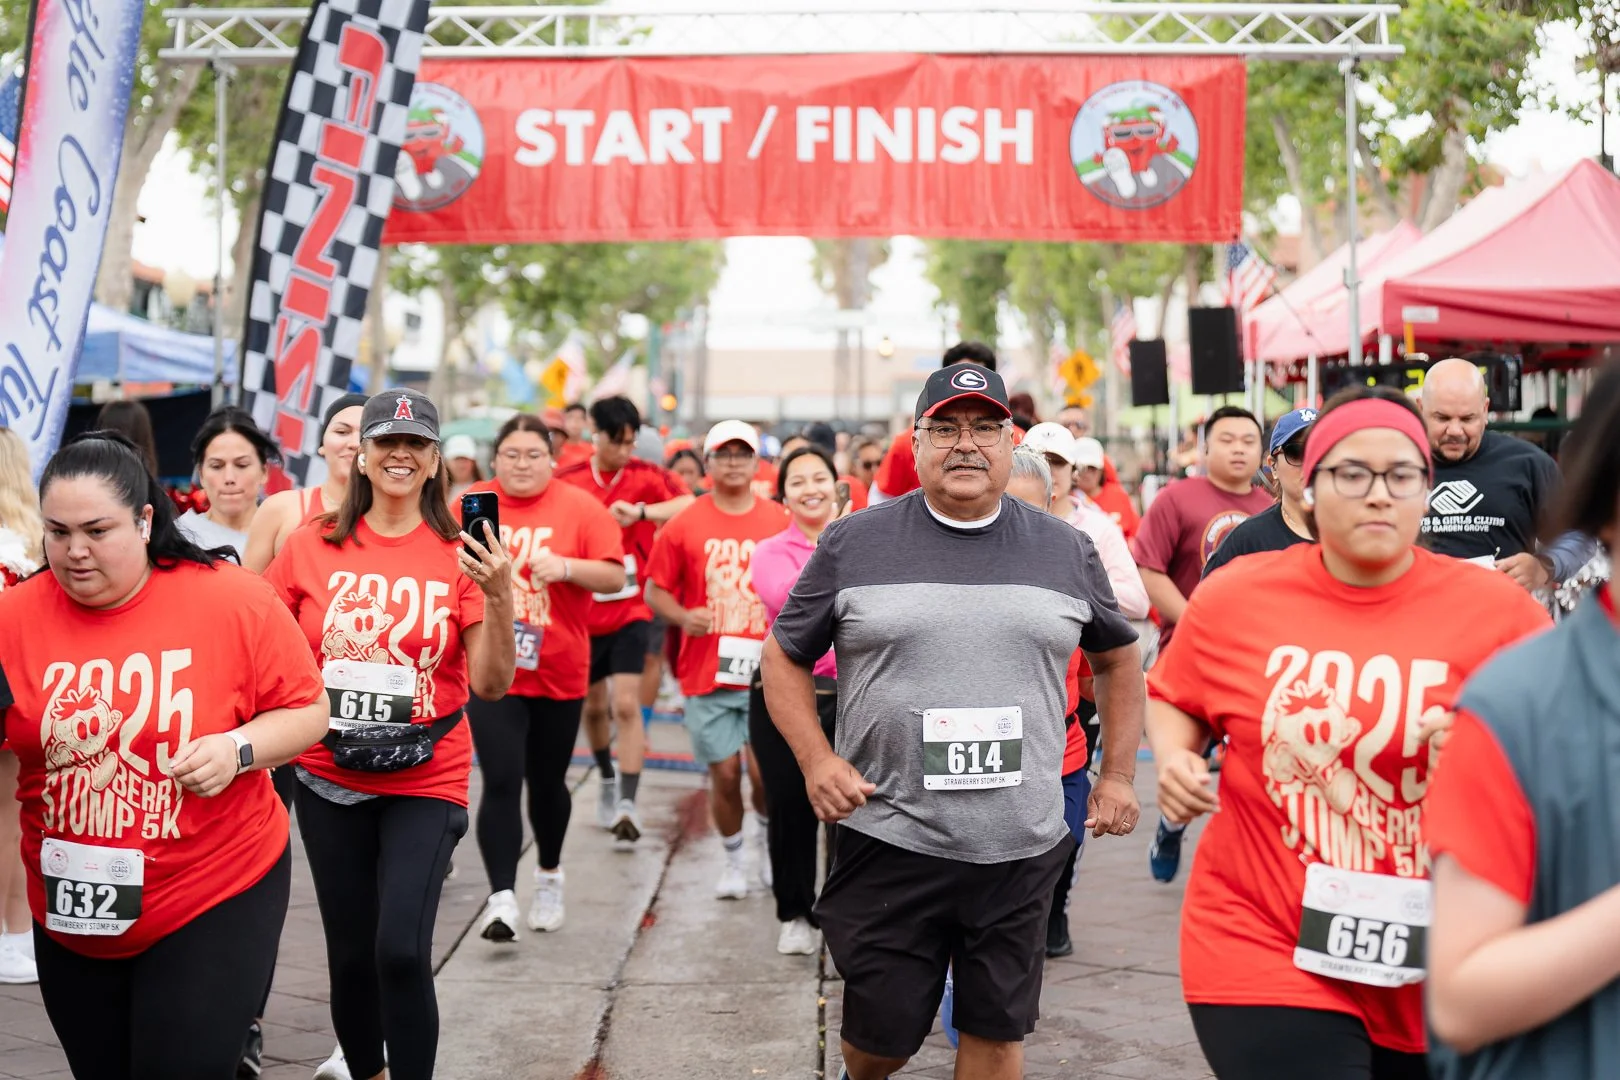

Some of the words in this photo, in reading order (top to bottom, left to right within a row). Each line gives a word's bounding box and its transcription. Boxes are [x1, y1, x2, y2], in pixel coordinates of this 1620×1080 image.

[513, 106, 732, 167] START
[745, 104, 779, 160] /
[796, 105, 1034, 165] FINISH
[28, 134, 101, 352] Coast
[393, 395, 413, 420] A
[1421, 525, 1431, 533] OF
[1432, 524, 1463, 533] GARDEN
[1464, 524, 1490, 533] GROVE
[1442, 515, 1472, 526] GIRLS
[1473, 516, 1505, 527] CLUBS
[704, 537, 760, 604] 202
[322, 571, 450, 669] 2025
[40, 648, 194, 778] 2025
[340, 690, 394, 722] 615
[1260, 645, 1450, 802] 2025
[944, 778, 979, 786] STRAWBERRY
[980, 777, 998, 785] STOMP
[947, 741, 1003, 774] 614
[41, 766, 135, 838] STOMP
[141, 796, 184, 840] 5K
[1352, 780, 1423, 845] BERR
[52, 918, 88, 930] STRAWBERRY
[88, 922, 111, 930] STOMP
[56, 880, 118, 919] 632
[1326, 914, 1411, 967] 656
